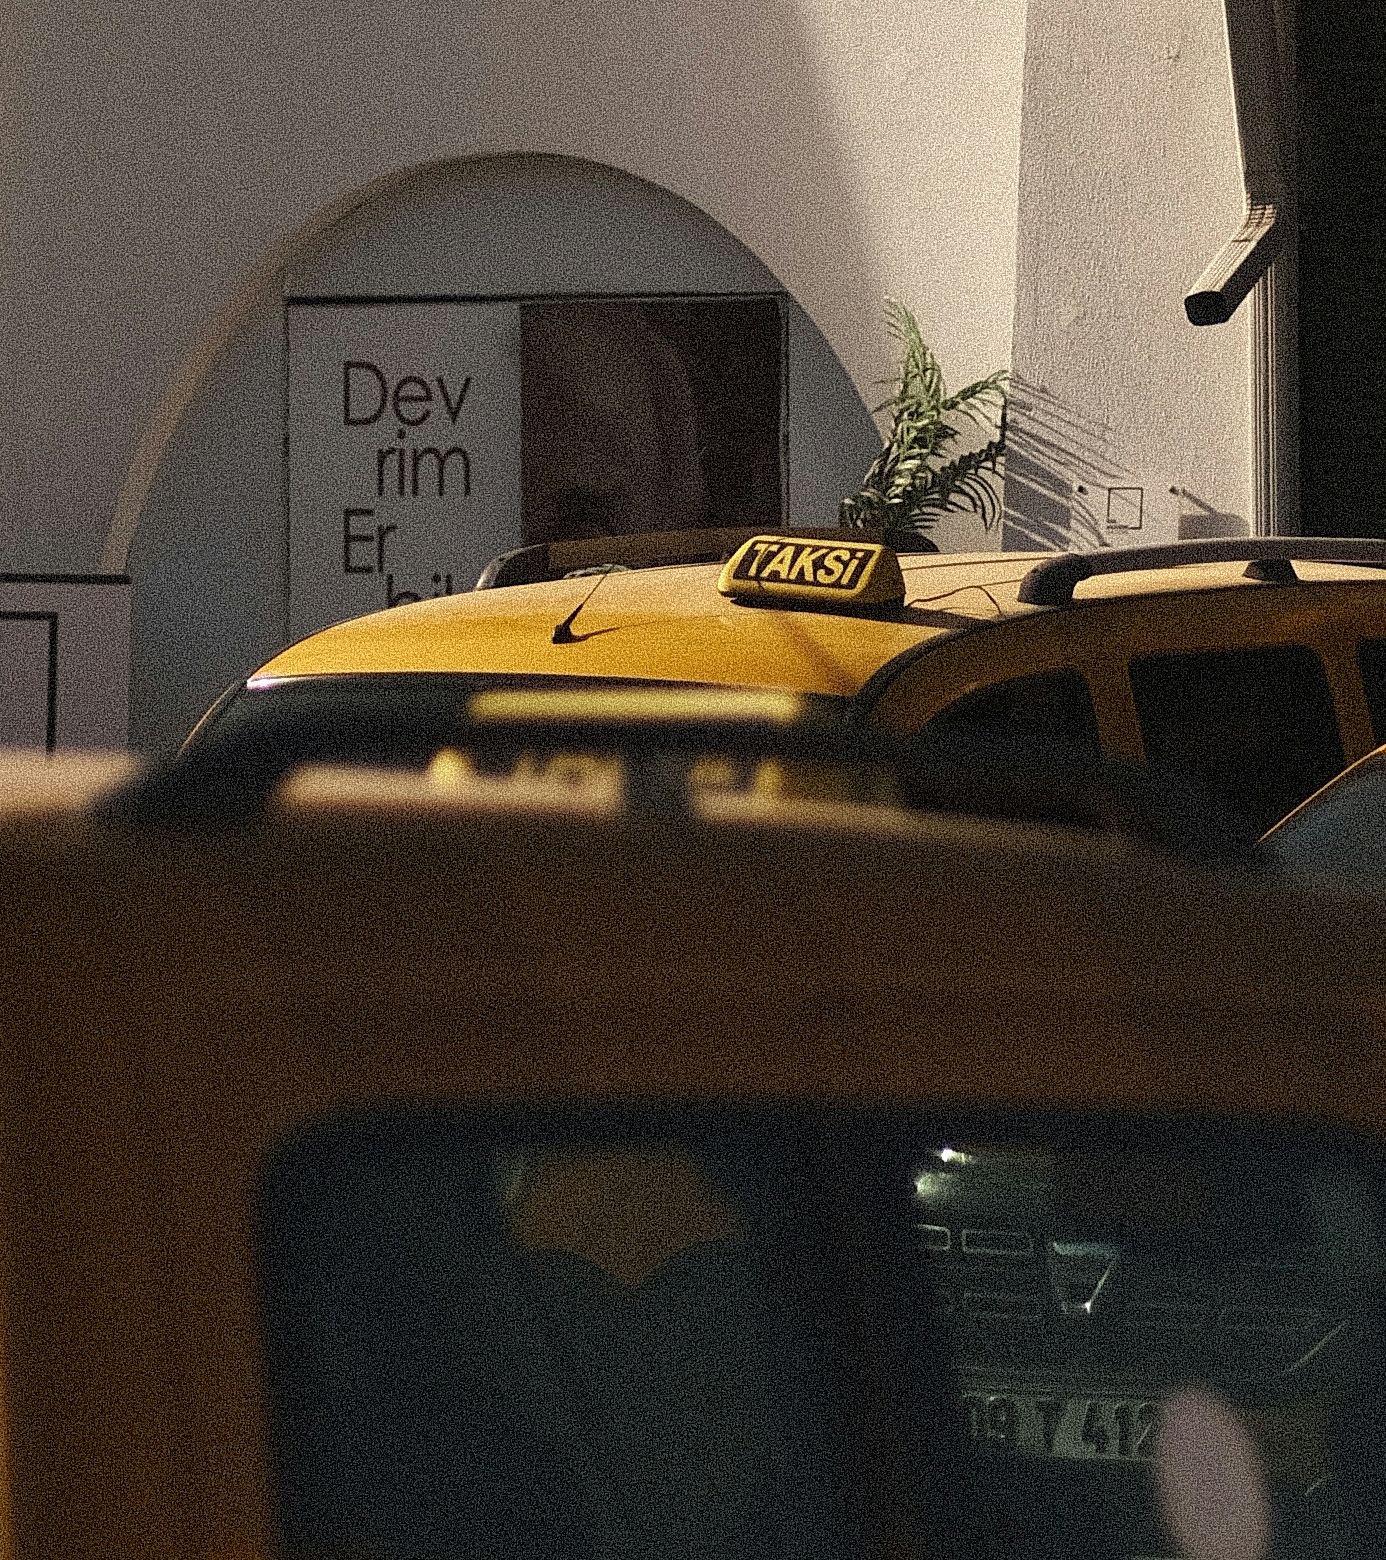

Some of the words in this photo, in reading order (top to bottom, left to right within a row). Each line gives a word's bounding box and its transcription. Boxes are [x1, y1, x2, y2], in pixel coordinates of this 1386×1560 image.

[343, 361, 472, 427] Dev
[376, 428, 472, 498] rim
[343, 508, 398, 574] Er
